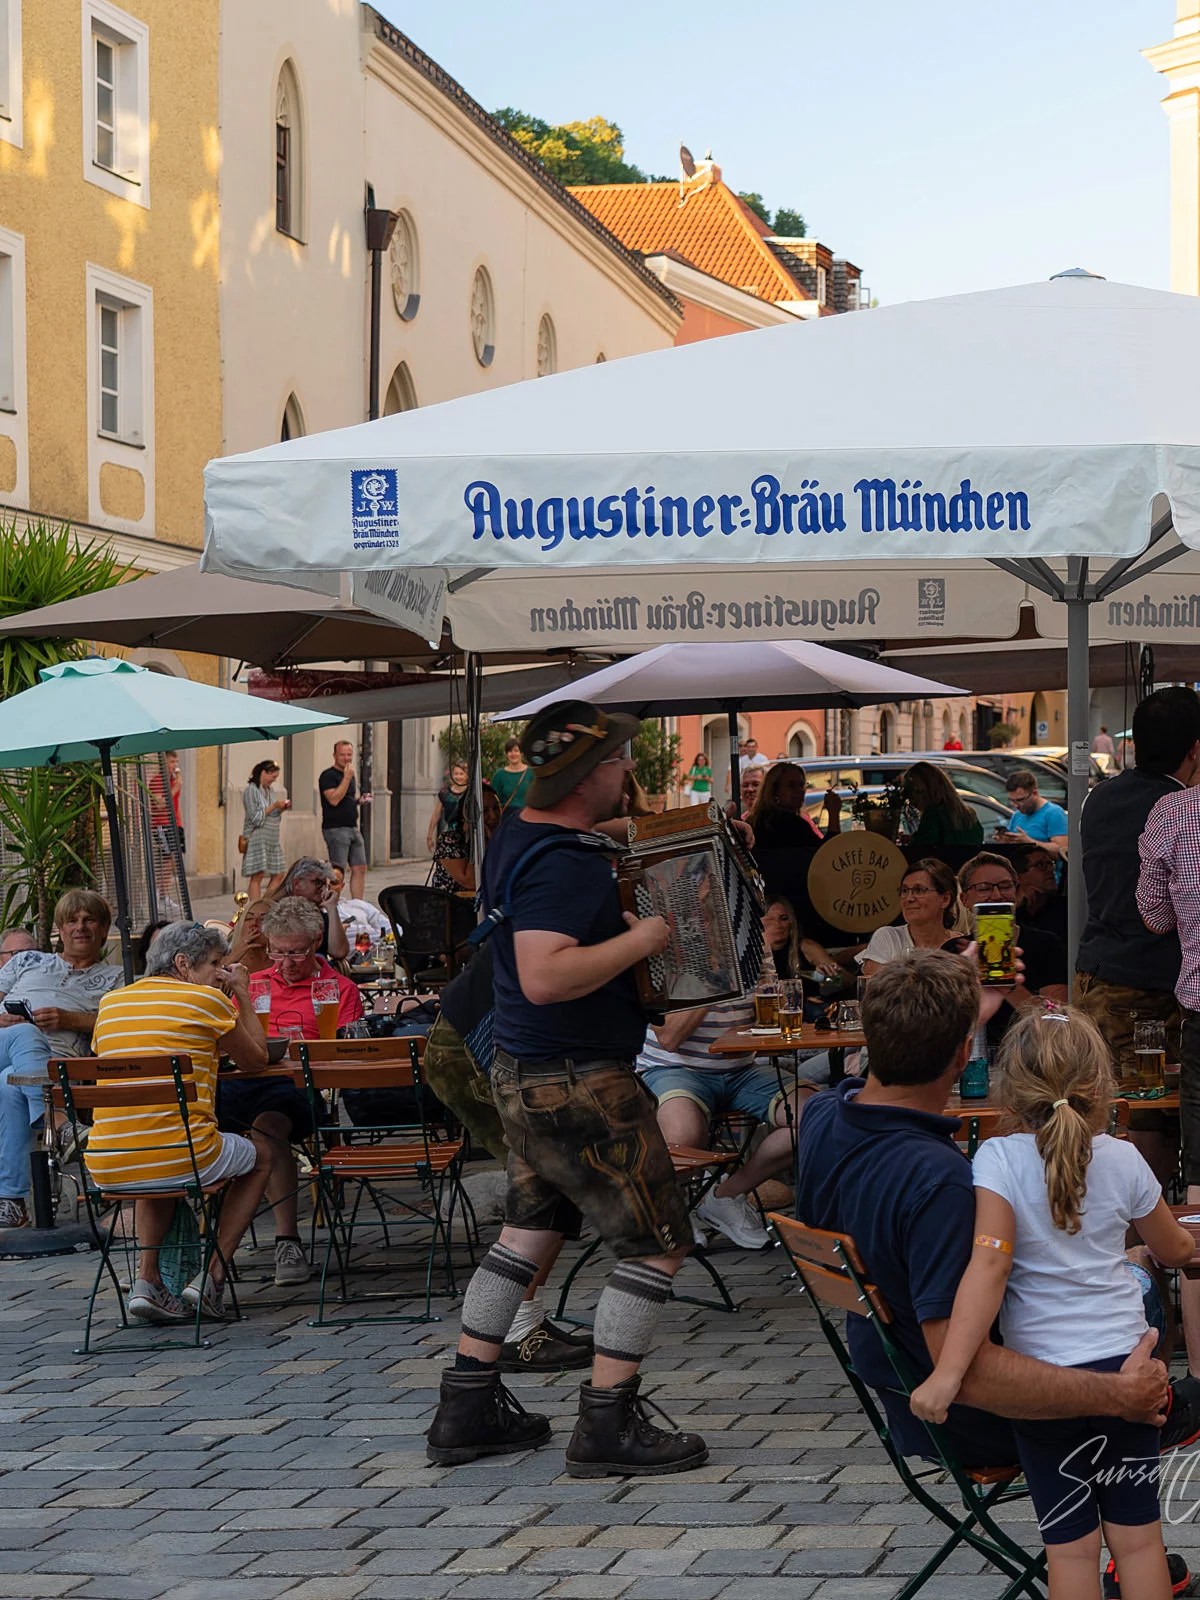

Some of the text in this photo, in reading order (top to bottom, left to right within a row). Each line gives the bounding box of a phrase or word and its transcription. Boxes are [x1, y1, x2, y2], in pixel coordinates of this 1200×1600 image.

[853, 479, 1032, 534] München
[868, 850, 889, 870] BAR
[832, 895, 891, 918] CENTRALE
